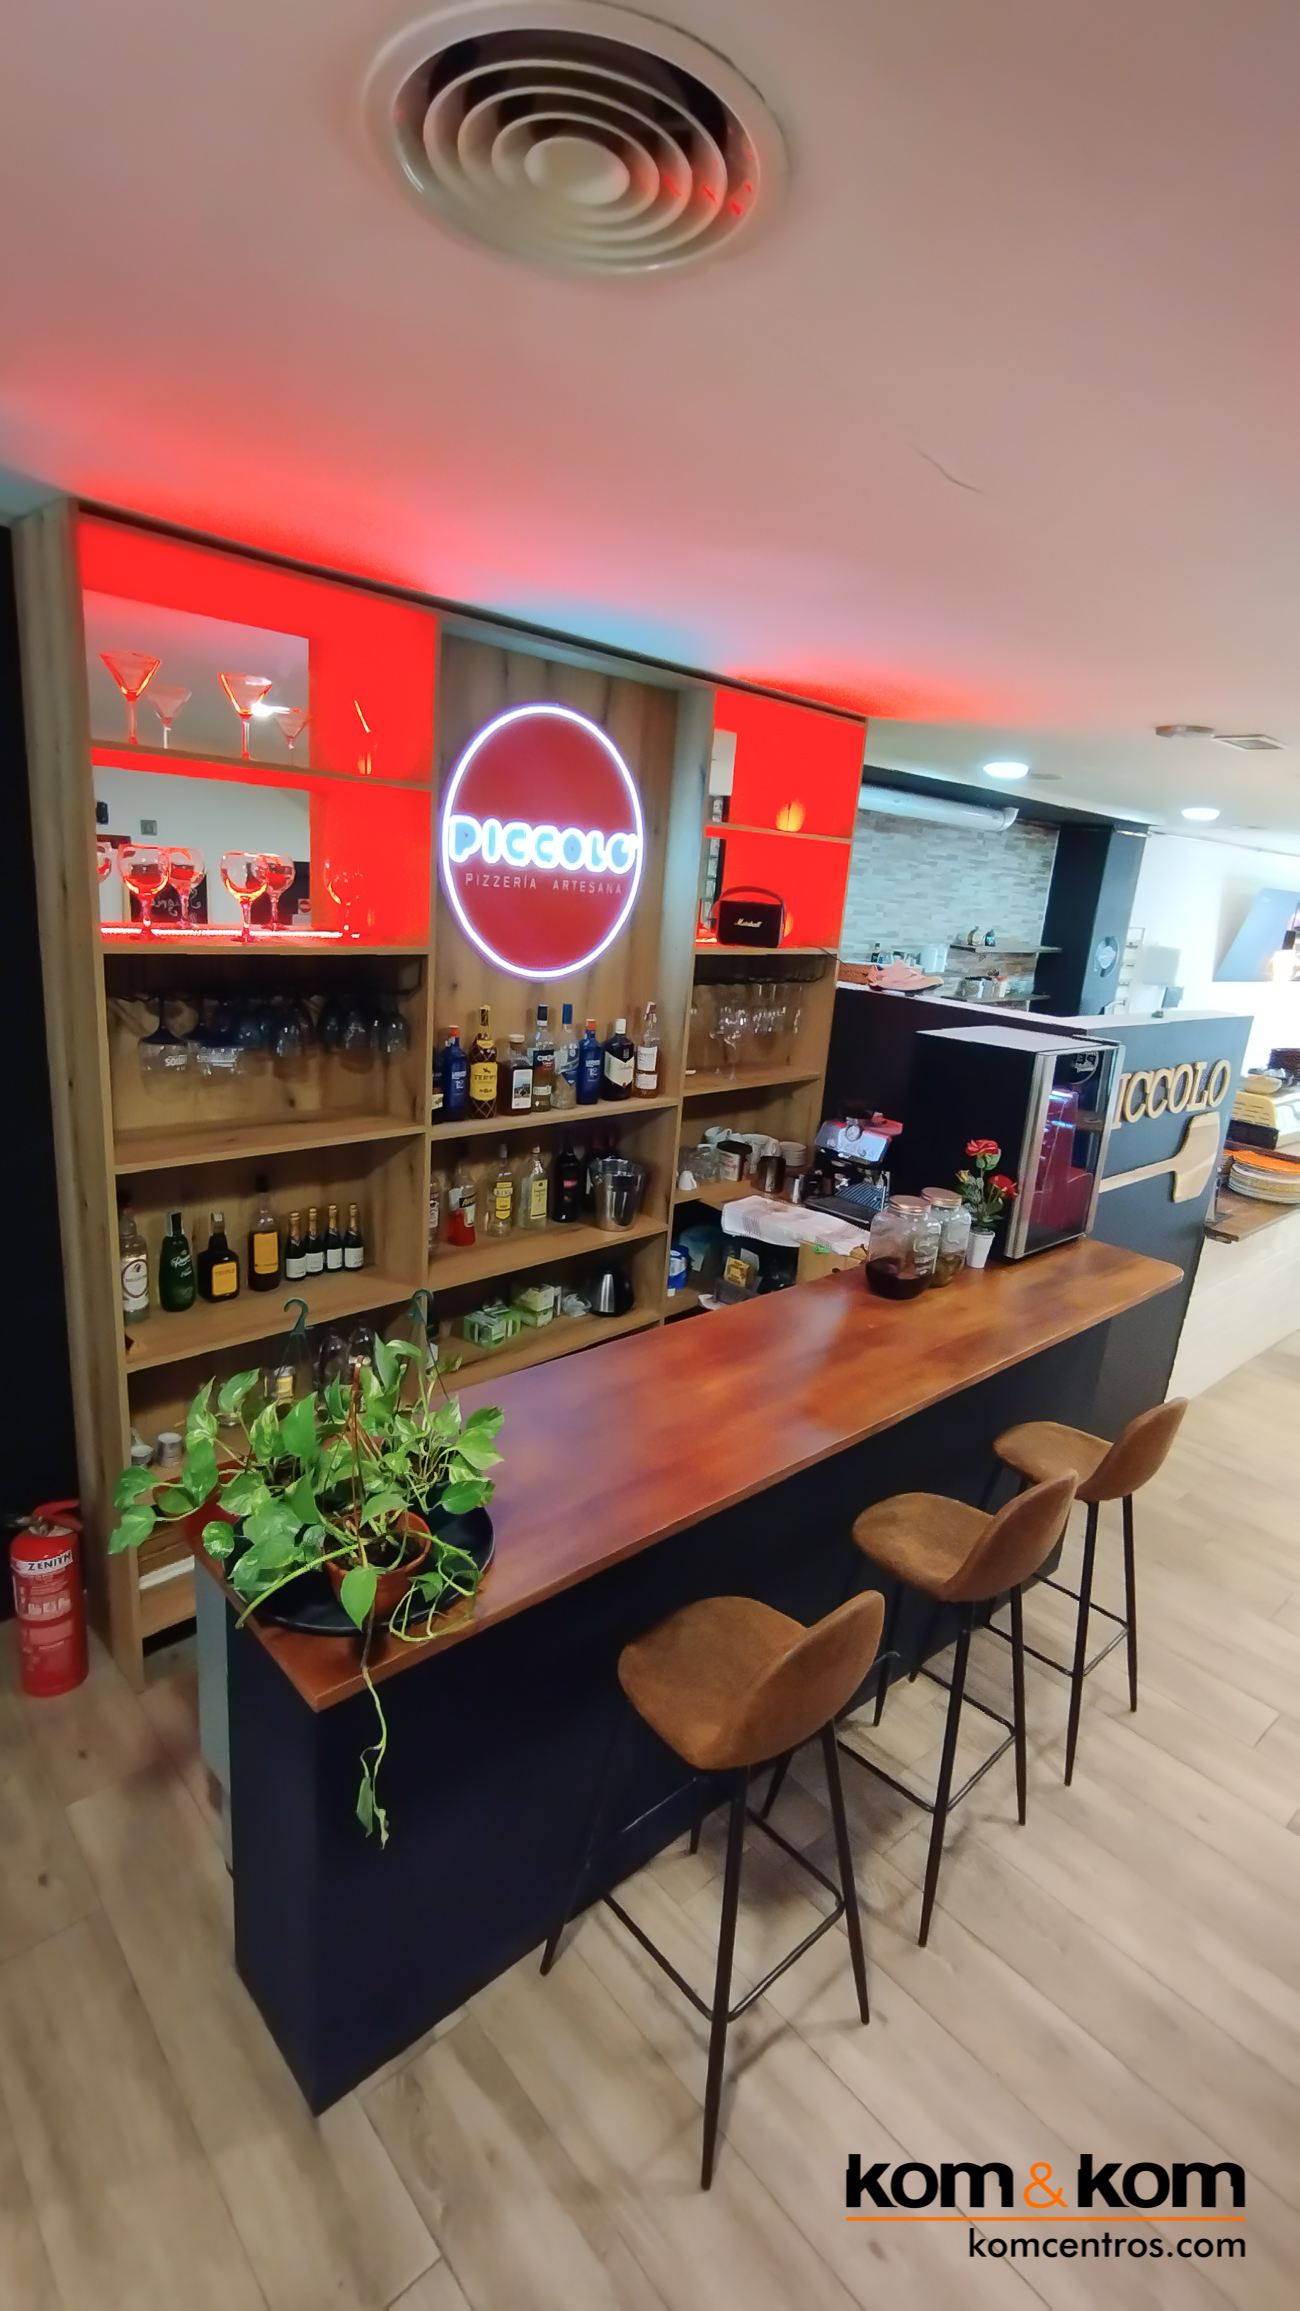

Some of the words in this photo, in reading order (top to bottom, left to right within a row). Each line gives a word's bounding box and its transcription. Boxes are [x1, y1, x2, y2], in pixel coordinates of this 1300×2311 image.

[449, 814, 638, 874] PICCOLO
[465, 872, 537, 890] PIZZERÍA
[552, 879, 622, 895] ARTESANA
[1111, 1059, 1232, 1130] ICCOLO
[28, 1552, 72, 1571] ZENITH
